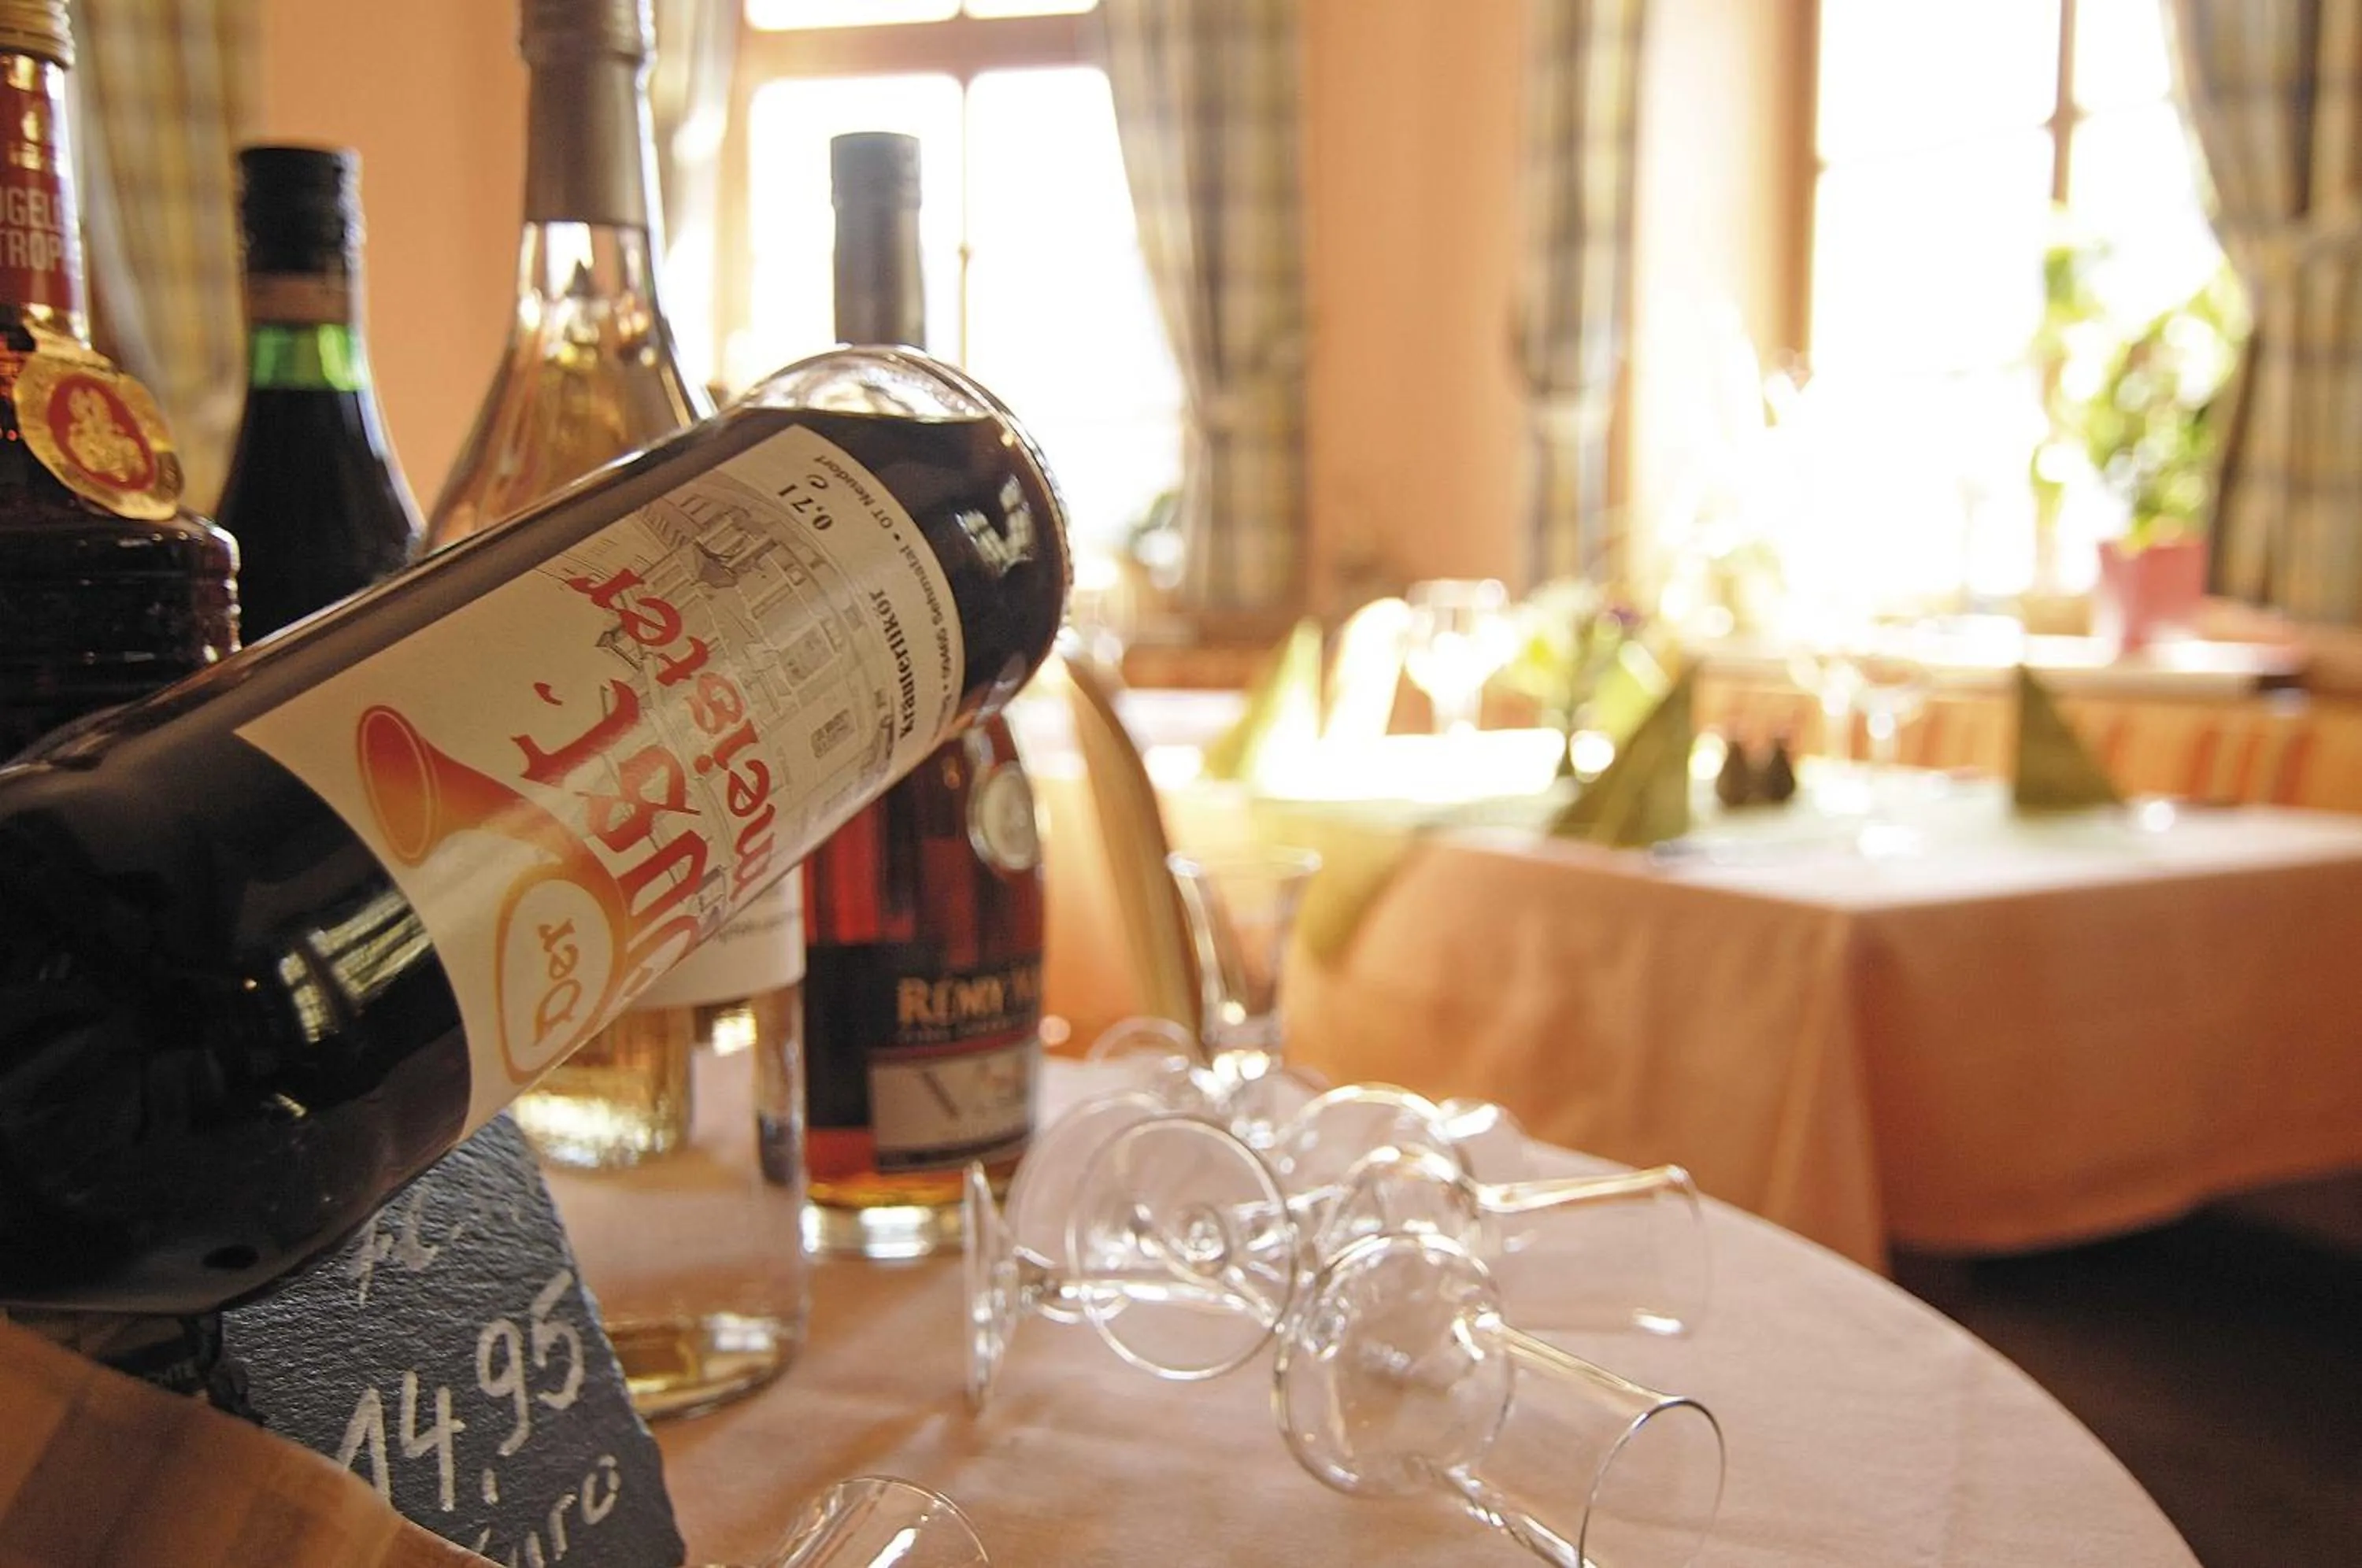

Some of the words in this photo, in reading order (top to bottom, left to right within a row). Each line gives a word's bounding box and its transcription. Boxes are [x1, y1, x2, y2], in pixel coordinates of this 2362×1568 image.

[789, 496, 835, 531] 0,7
[813, 453, 876, 508] Neudorf
[871, 507, 894, 531] OT
[898, 544, 943, 626] Sehmatal
[868, 589, 916, 740] Kräuterlikör
[568, 568, 776, 902] meister
[533, 918, 583, 1047] Der
[335, 1269, 585, 1513] 14,95
